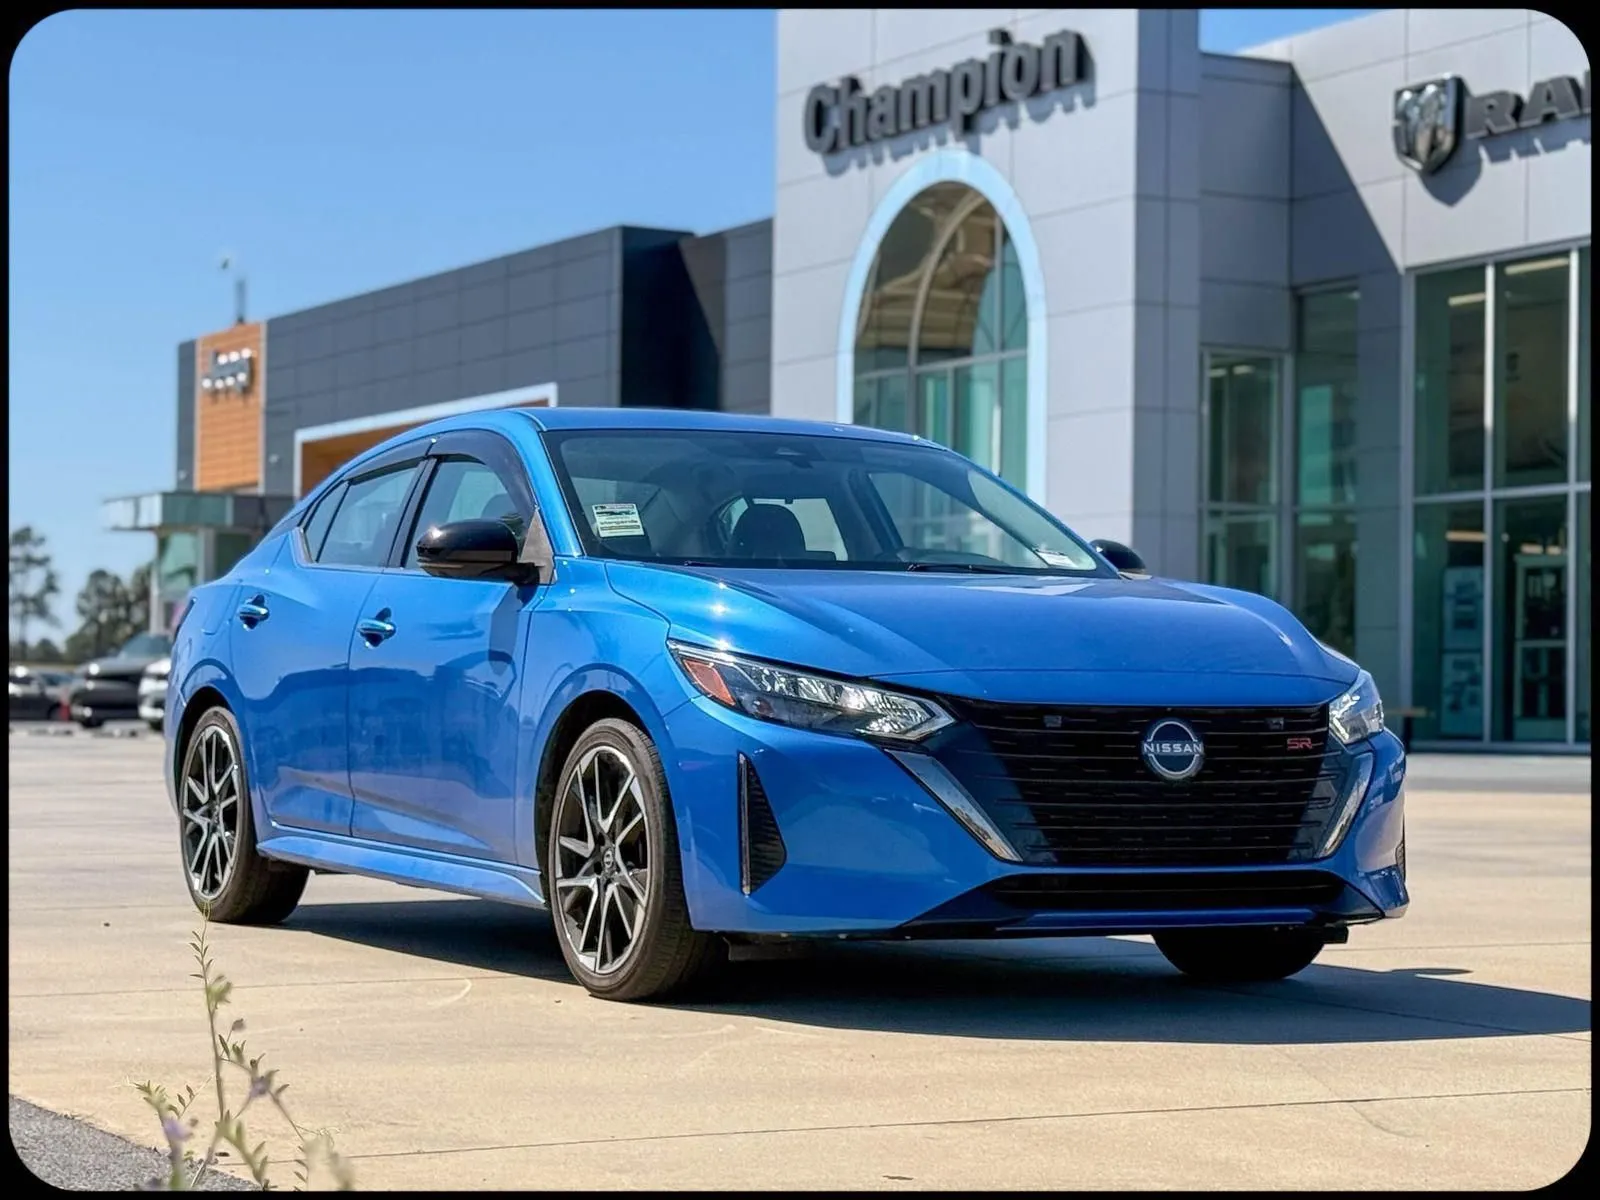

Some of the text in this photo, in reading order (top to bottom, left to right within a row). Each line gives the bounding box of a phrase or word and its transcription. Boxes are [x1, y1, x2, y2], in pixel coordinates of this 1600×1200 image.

[804, 28, 1091, 154] Champion
[1464, 70, 1591, 140] RA
[1143, 743, 1203, 753] NISSAN
[1287, 737, 1312, 749] SR
